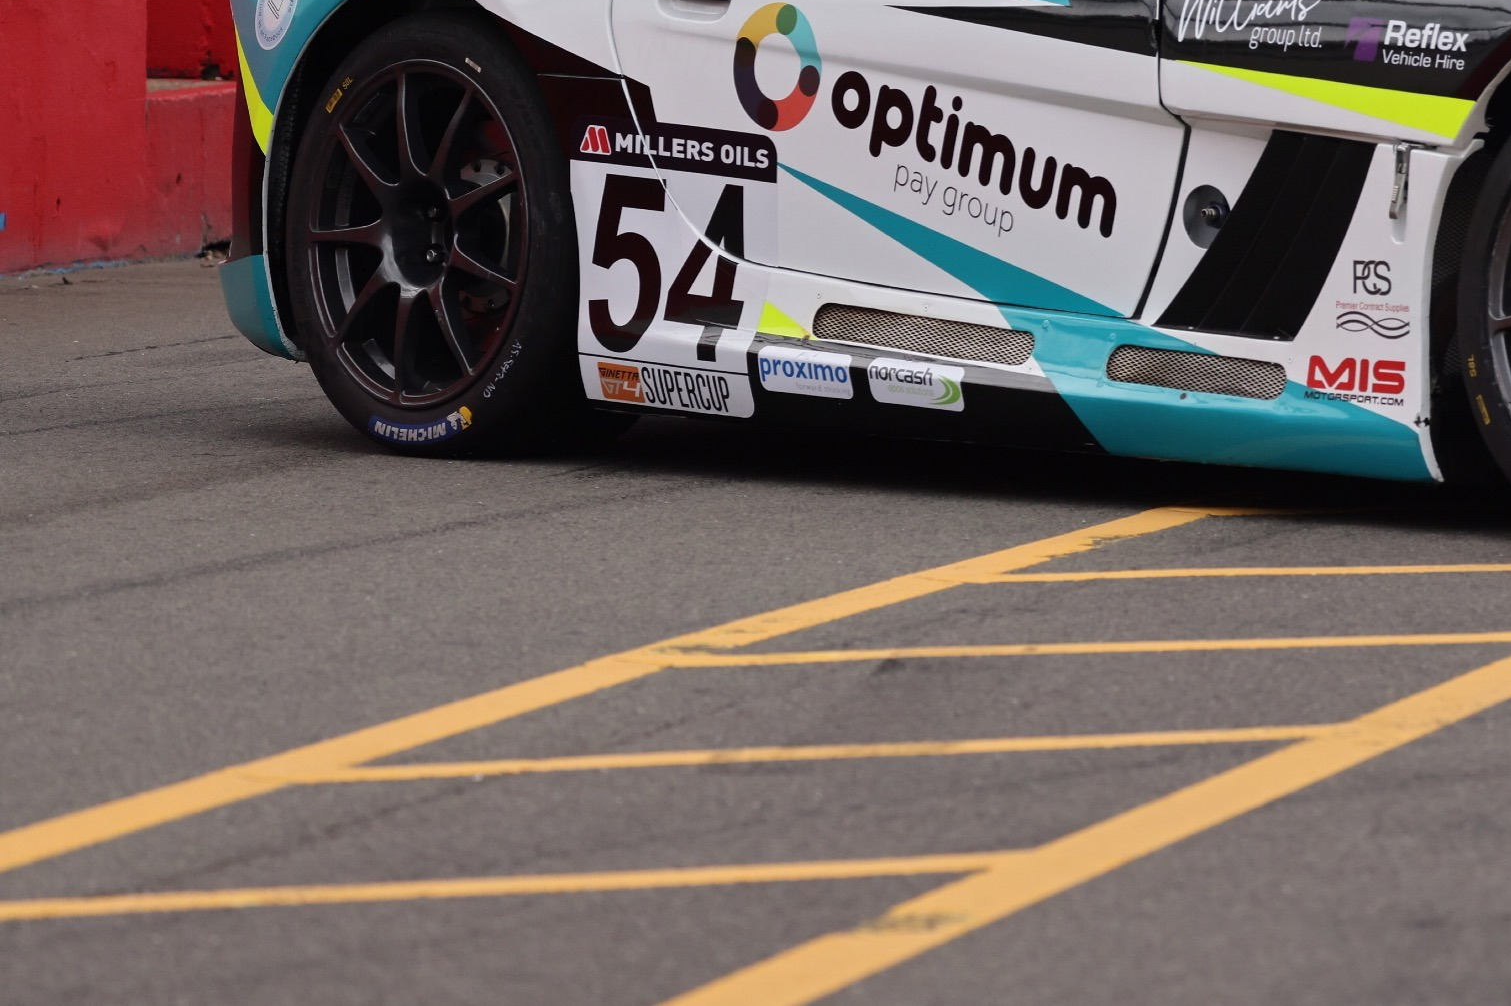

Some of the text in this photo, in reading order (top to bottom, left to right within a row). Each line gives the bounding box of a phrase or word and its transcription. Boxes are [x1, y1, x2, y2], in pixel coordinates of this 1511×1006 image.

[1249, 25, 1323, 52] group ltd.
[1384, 19, 1470, 52] Reflex
[1381, 49, 1465, 71] Vehicle Hire
[615, 132, 769, 168] MILLERS OILS
[831, 72, 1118, 238] optimum
[894, 163, 1015, 237] pay group
[588, 173, 746, 362] 54
[1353, 260, 1392, 296] PCS
[1335, 300, 1410, 313] Premier Contract Supplies
[598, 367, 640, 381] GINETTA
[759, 357, 848, 383] proximo
[868, 365, 933, 386] norcash
[1306, 355, 1406, 395] MIS
[601, 378, 641, 398] GT4
[641, 366, 730, 413] SUPERCUP
[905, 385, 934, 395] solutions
[1303, 390, 1404, 407] MOTORSPORT.COM
[374, 419, 446, 443] MICHELIN
